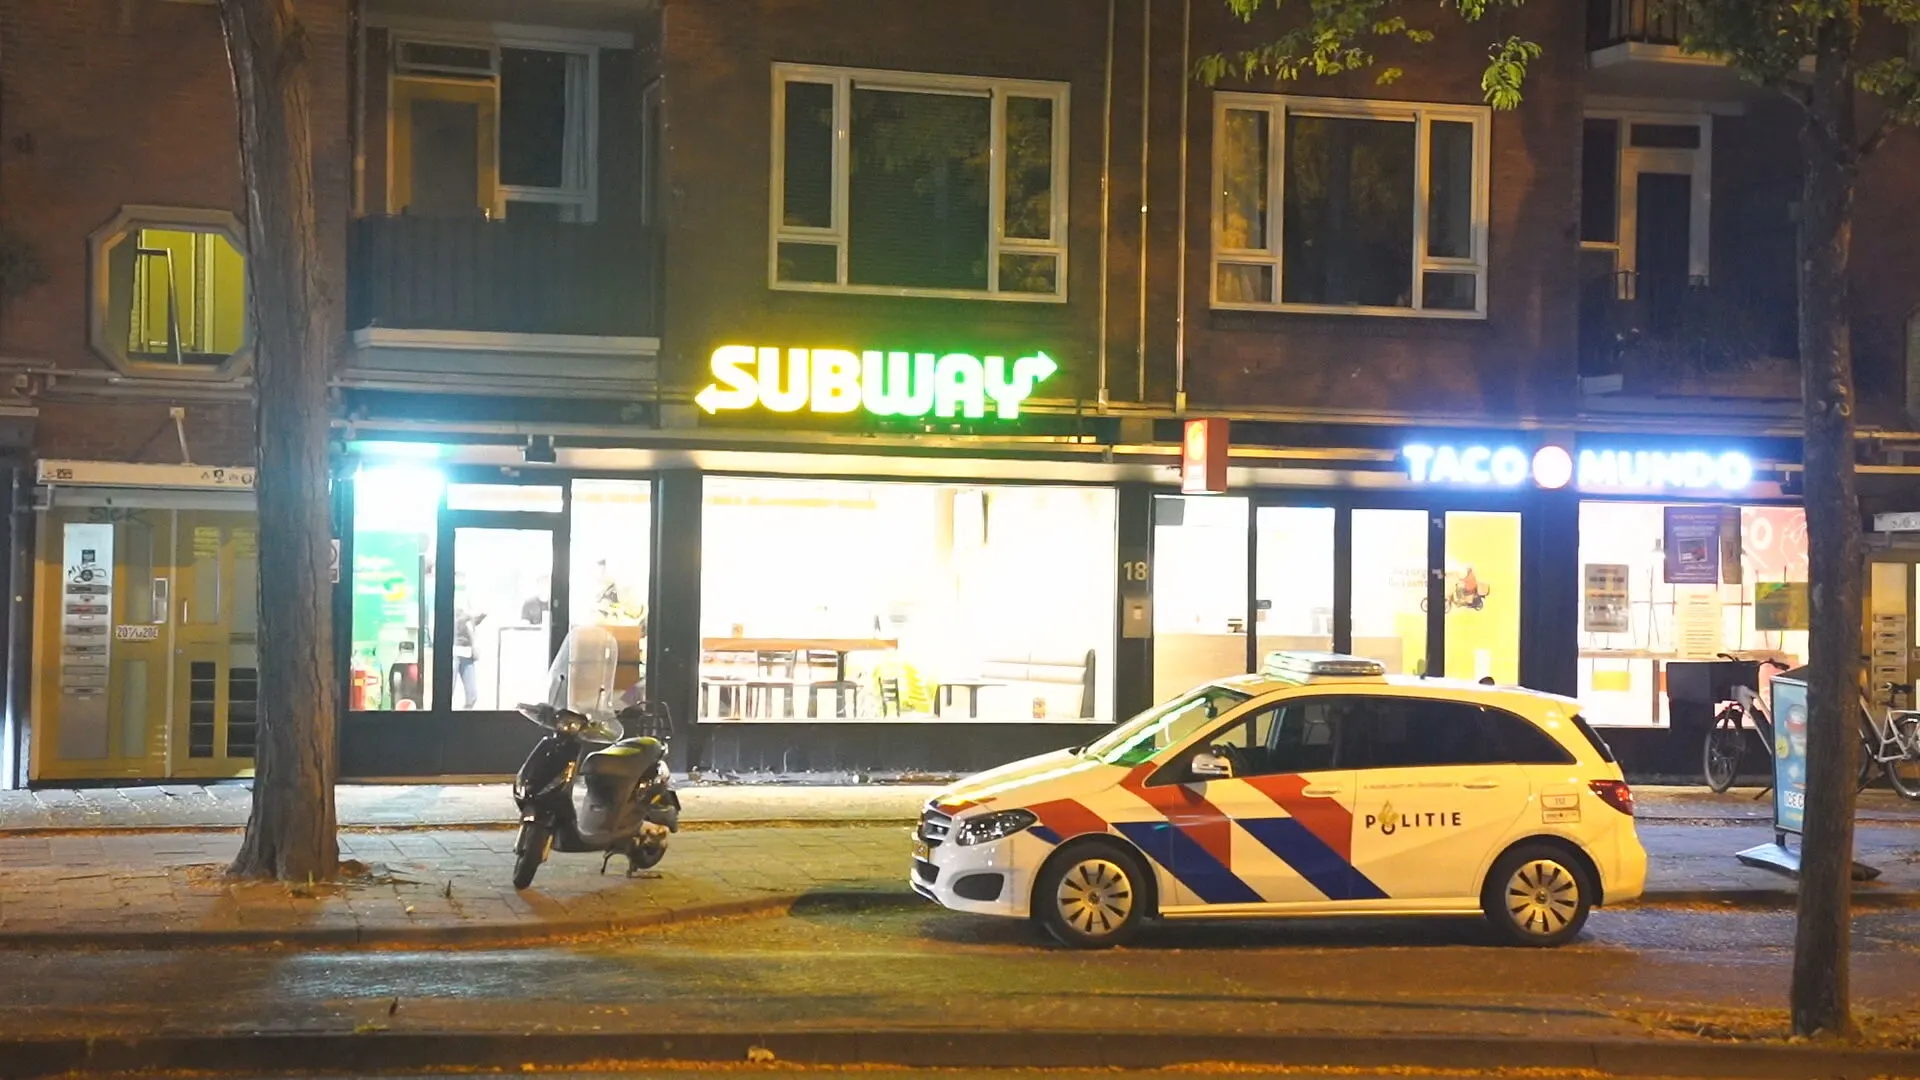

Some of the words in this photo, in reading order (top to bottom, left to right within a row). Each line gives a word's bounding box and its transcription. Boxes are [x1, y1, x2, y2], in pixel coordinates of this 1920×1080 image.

[695, 345, 1058, 419] SUBWAY
[1402, 445, 1528, 486] TACO
[1578, 449, 1753, 490] MUNDO
[1123, 561, 1148, 581] 18
[1365, 811, 1462, 835] POLITIE
